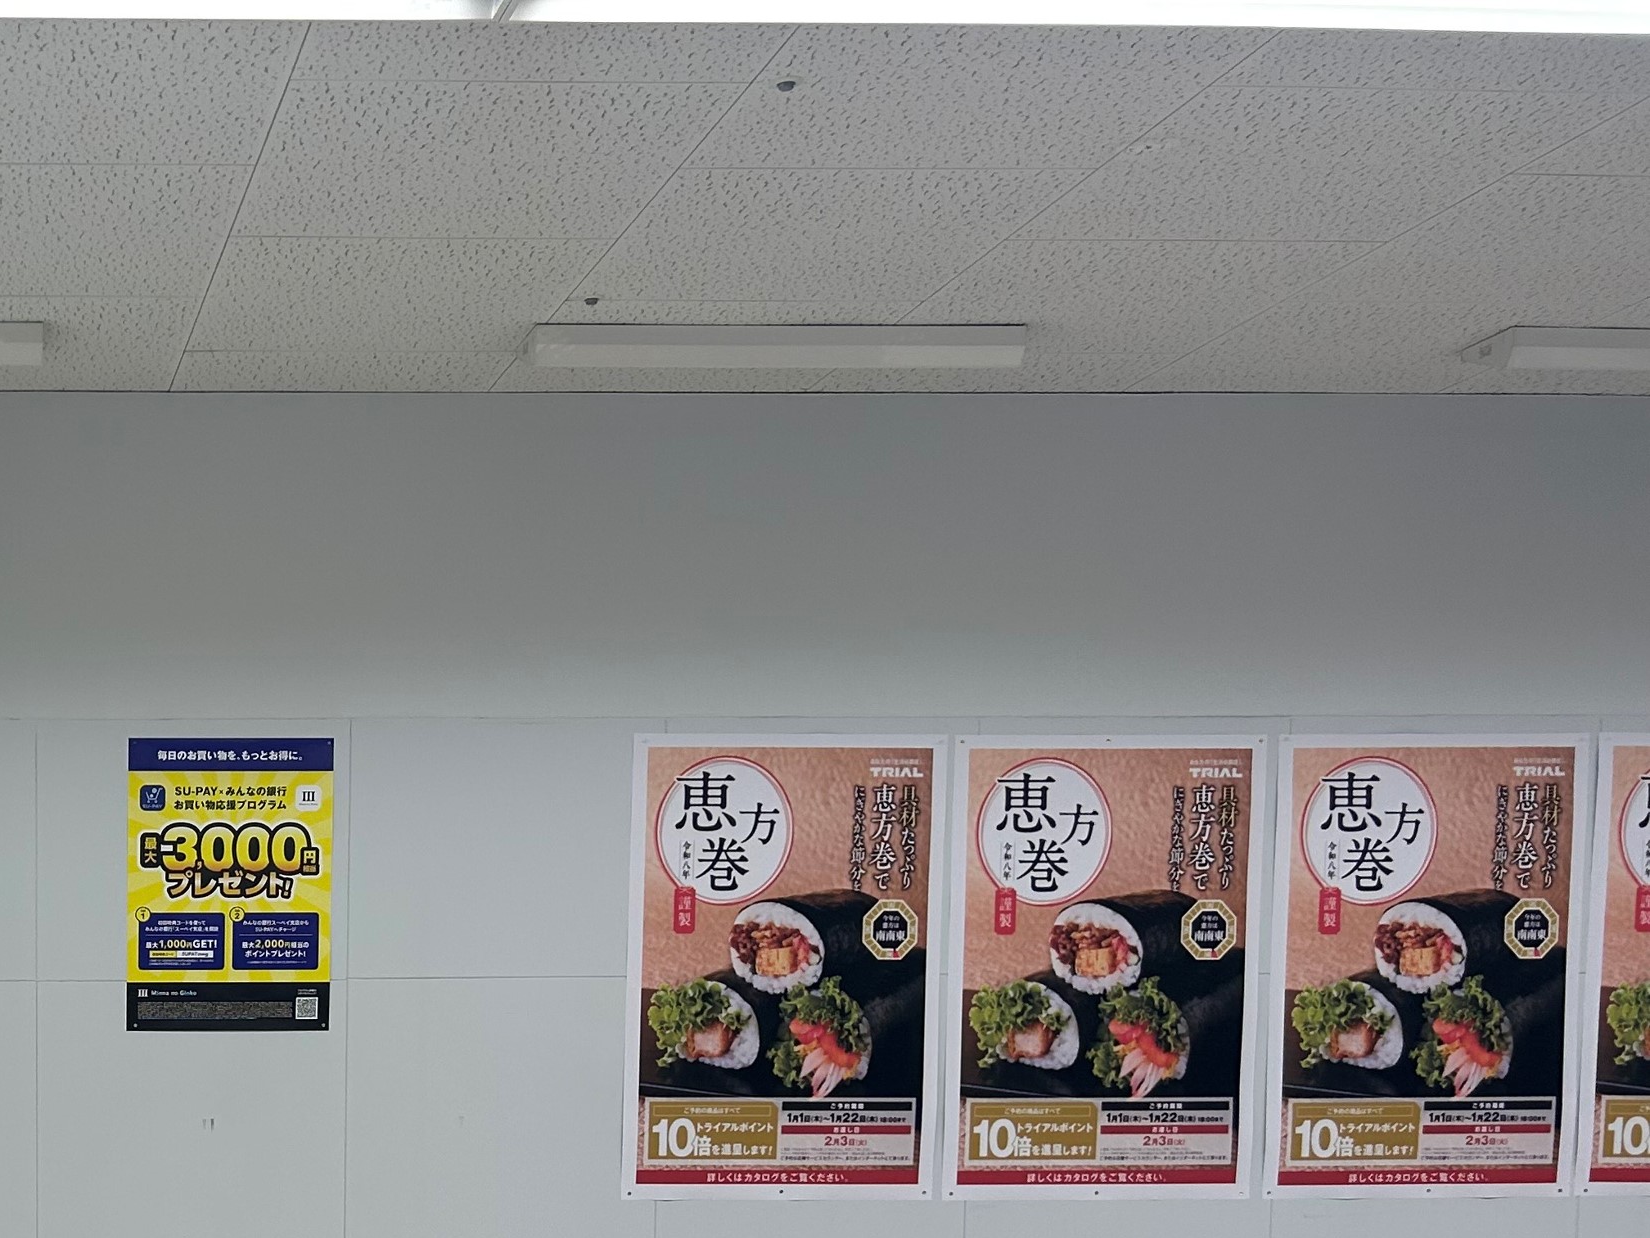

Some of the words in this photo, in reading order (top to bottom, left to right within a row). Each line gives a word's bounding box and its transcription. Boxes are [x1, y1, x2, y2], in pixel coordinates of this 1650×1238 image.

[157, 750, 303, 761] 毎日のお買い物を、もっとお得に。
[870, 767, 924, 778] TRIAL
[1189, 767, 1243, 778] TRIAL
[1513, 766, 1565, 777] TRIAL
[174, 800, 287, 811] お買い物応援プログラム
[674, 771, 780, 891] 恵方巻
[869, 783, 896, 890] 恵方巻で
[996, 773, 1099, 892] 恵方巻
[1188, 783, 1216, 890] 恵方巻で
[1320, 772, 1425, 892] 恵方巻
[1512, 782, 1539, 889] 恵方巻で
[1542, 785, 1561, 889] 具材たっぷり
[850, 786, 866, 891] にぎやかな節分を
[899, 786, 920, 890] 具材たっぷり
[1169, 786, 1185, 892] にぎやかな節分を
[1218, 786, 1239, 890] 具材たっぷり
[1493, 786, 1508, 890] にぎやかな節分を
[144, 837, 157, 863] 最大
[167, 869, 293, 896] プレゼント!
[876, 930, 906, 942] 南南東
[1194, 930, 1225, 942] 南南東
[1518, 929, 1546, 941] 南南東
[245, 950, 306, 958] ポイントプレゼント!
[696, 1122, 774, 1133] トライアルポイント
[1017, 1123, 1093, 1133] トライアルポイント
[1340, 1122, 1416, 1133] トライアルポイント
[706, 1172, 848, 1183] 詳しくはカタログをご覧ください。
[1027, 1172, 1166, 1183] 詳しくはカタログをご覧ください。
[1348, 1172, 1488, 1183] 詳しくはカタログをご覧ください。
